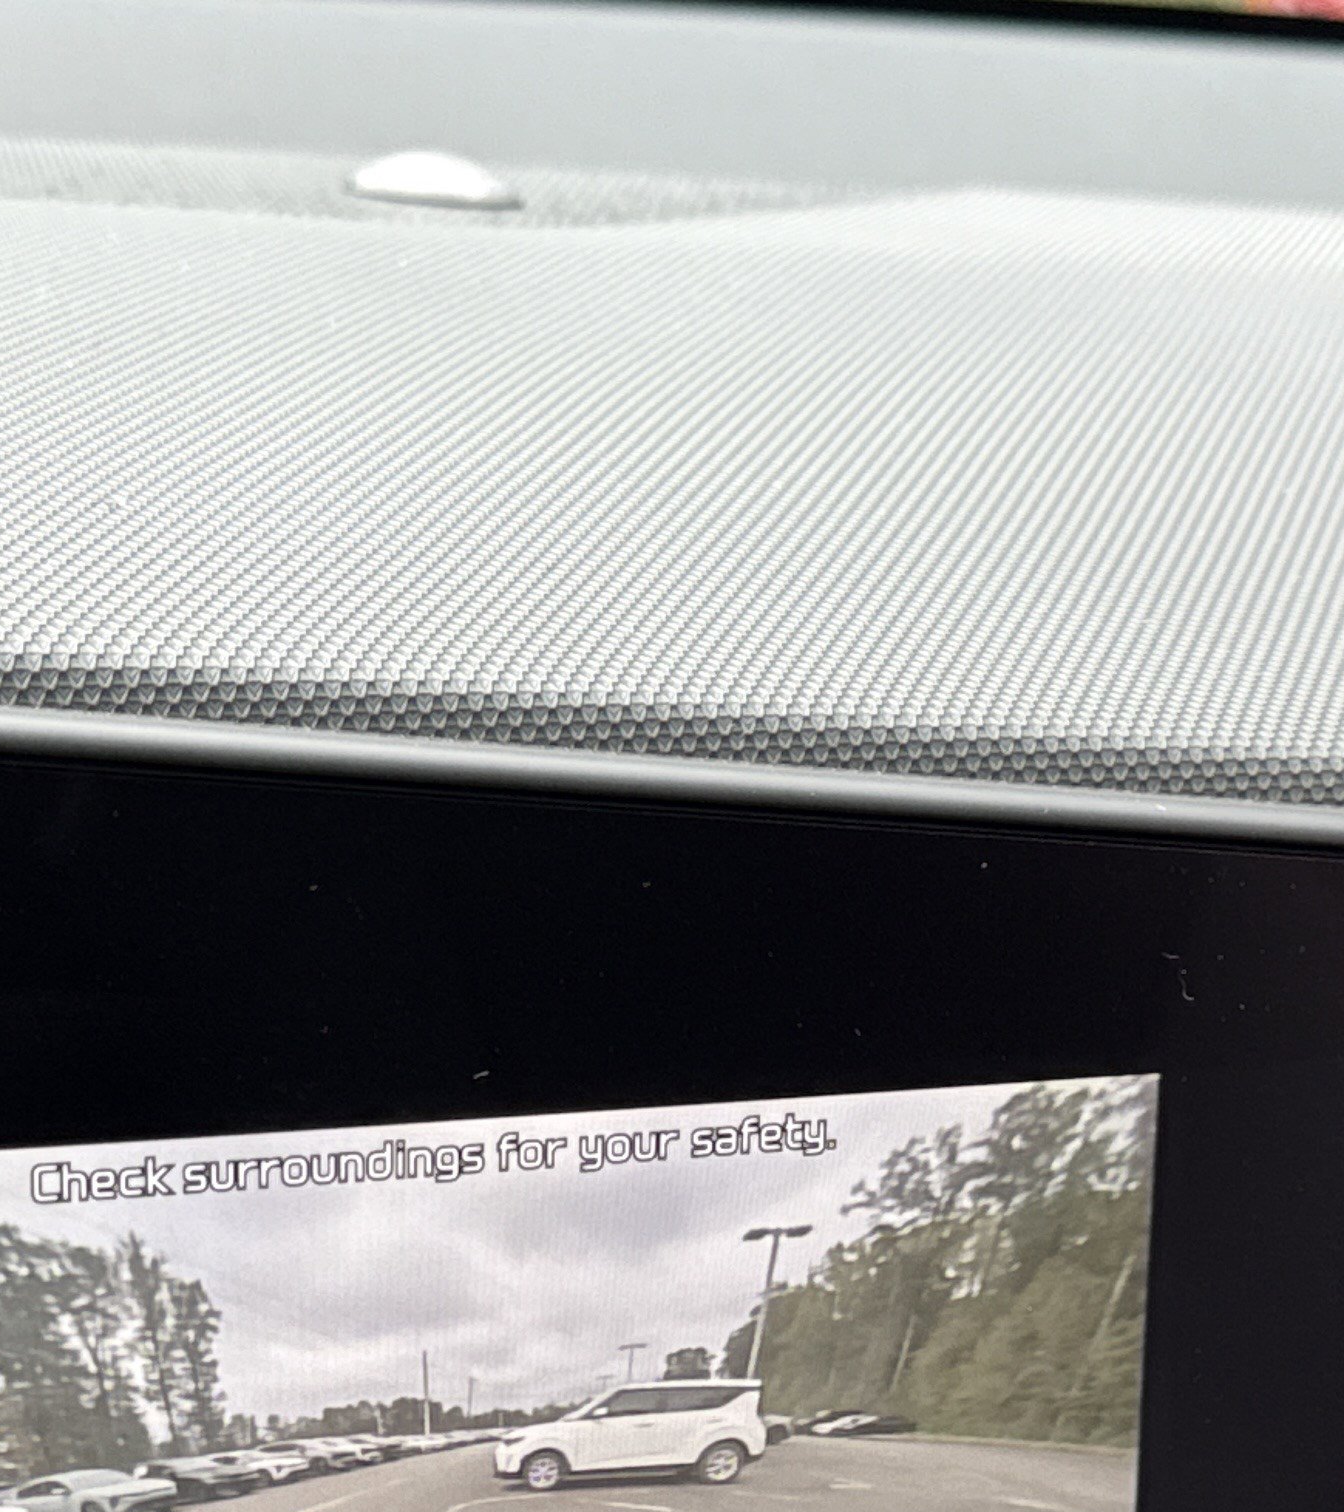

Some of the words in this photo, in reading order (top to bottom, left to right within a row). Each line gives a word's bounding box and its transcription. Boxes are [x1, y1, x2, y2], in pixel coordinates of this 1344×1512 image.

[30, 1156, 176, 1204] Check
[182, 1139, 485, 1194] surroundings
[498, 1131, 567, 1172] for
[579, 1129, 680, 1173] your
[691, 1112, 837, 1158] safety.
